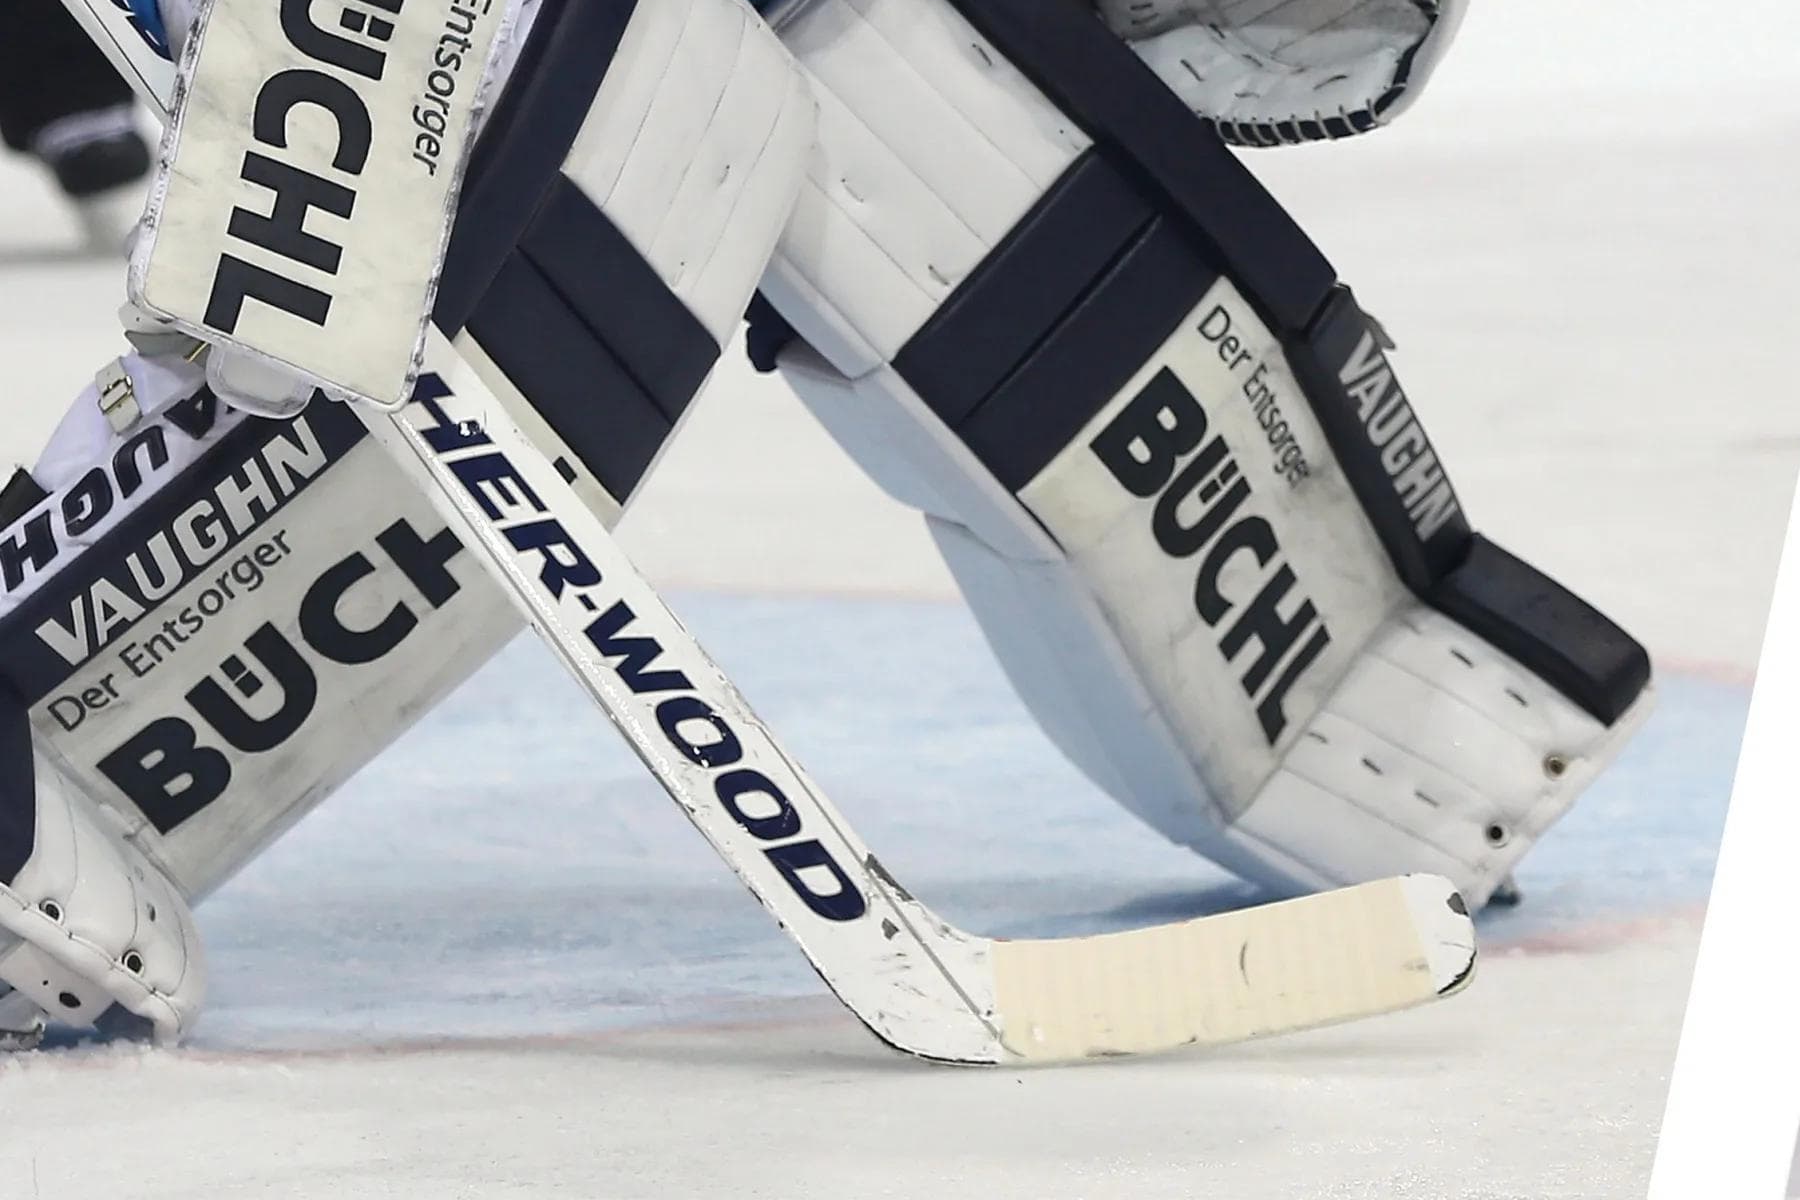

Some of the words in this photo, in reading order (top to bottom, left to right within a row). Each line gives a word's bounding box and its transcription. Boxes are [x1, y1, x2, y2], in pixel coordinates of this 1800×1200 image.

[1197, 304, 1253, 371] Der
[1242, 362, 1311, 491] Entsorger
[1337, 329, 1458, 542] VAUGHN
[34, 415, 328, 668] VAUGHN
[47, 674, 121, 732] Der
[118, 528, 293, 678] Entsorger
[1088, 364, 1332, 747] BÜCHL
